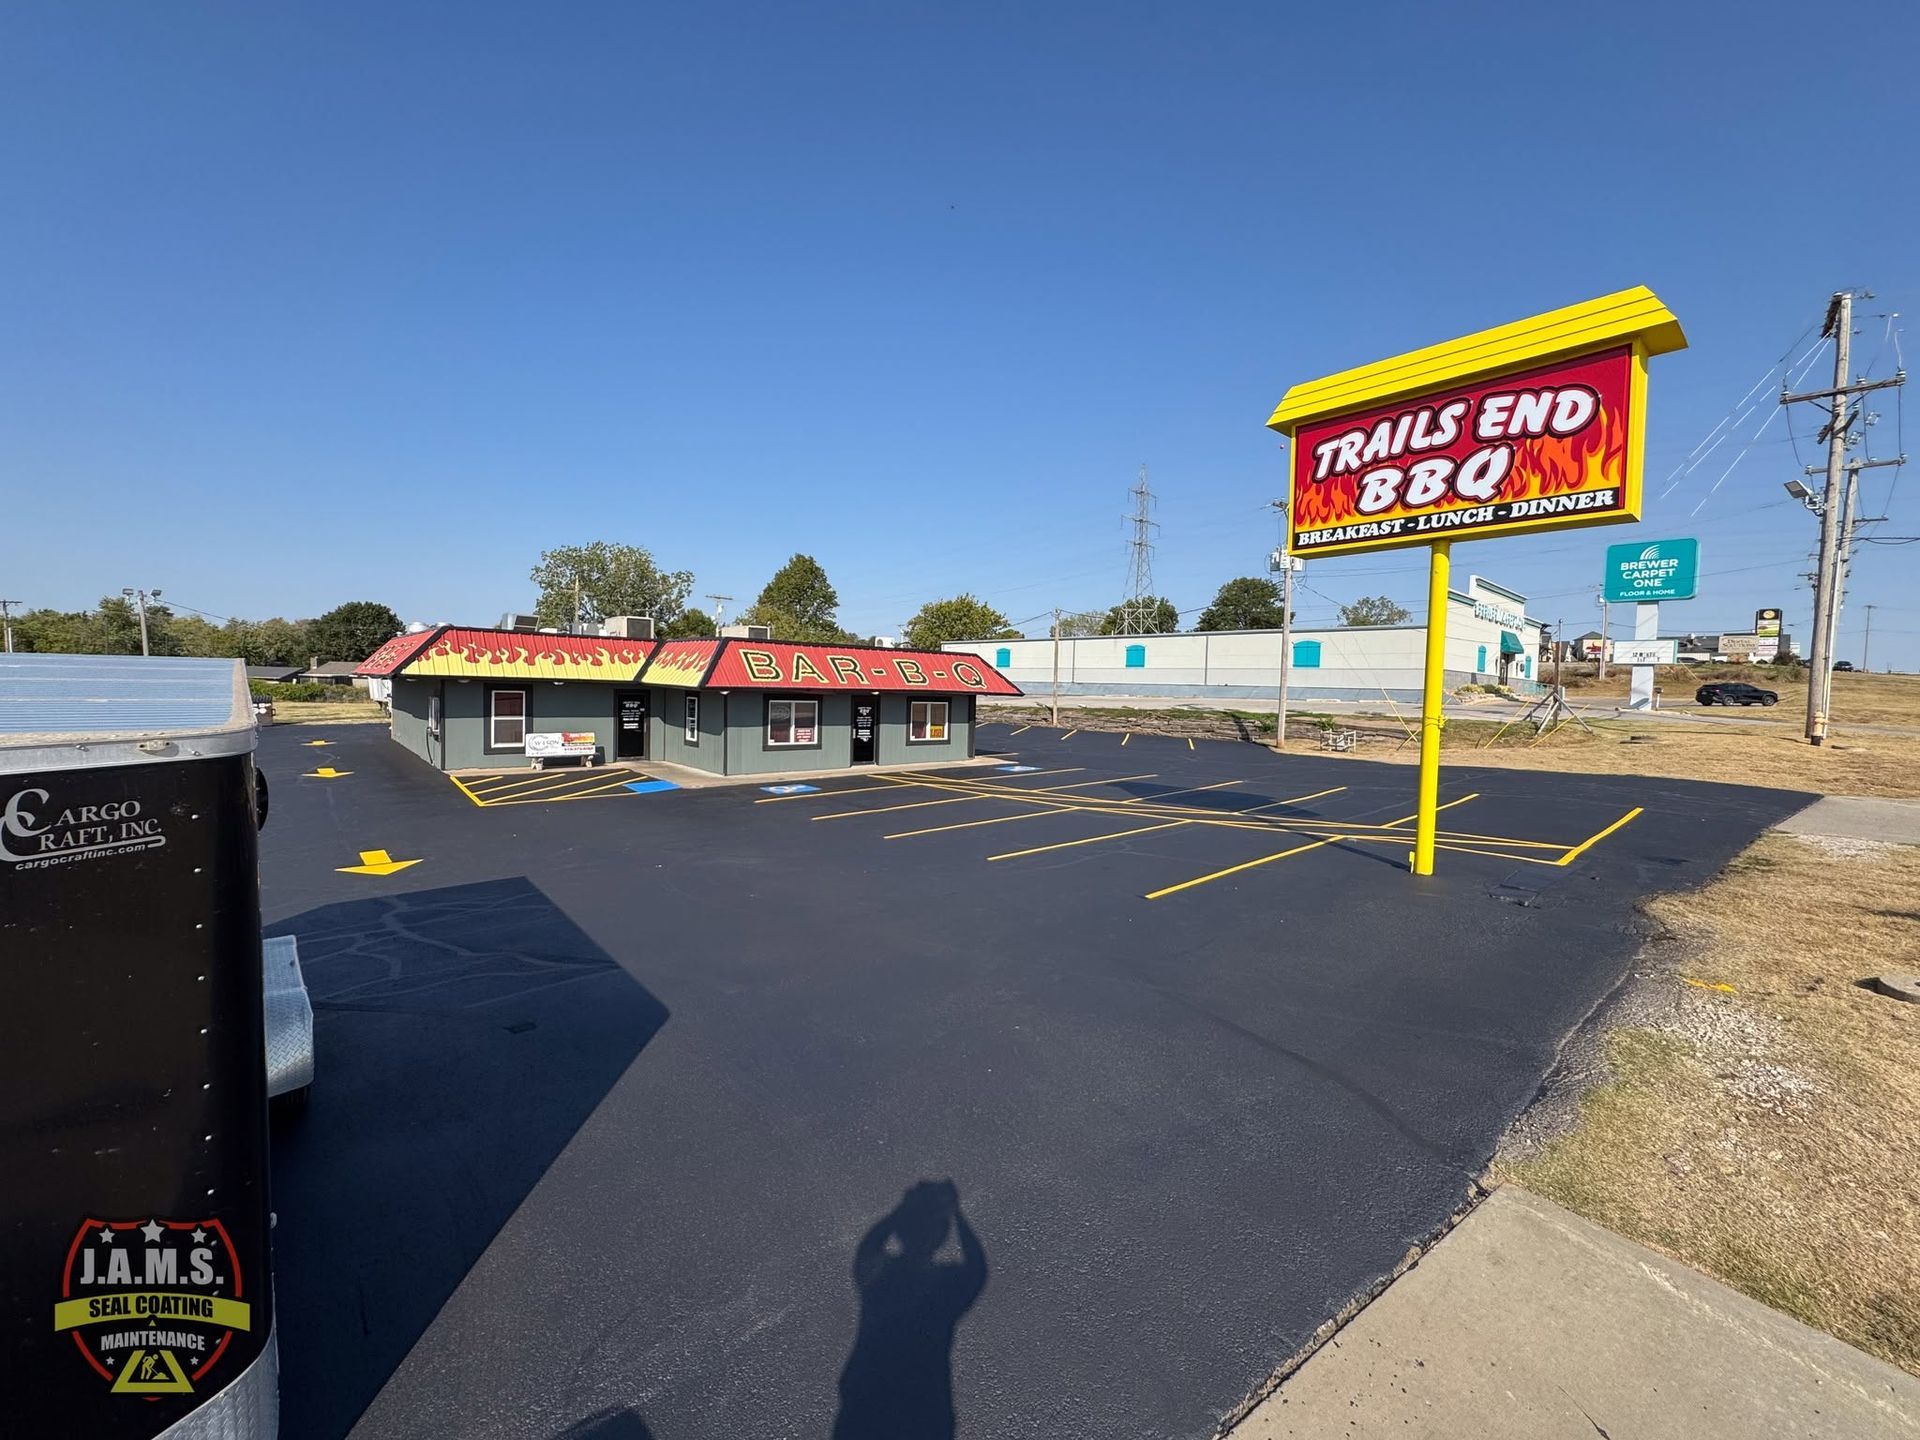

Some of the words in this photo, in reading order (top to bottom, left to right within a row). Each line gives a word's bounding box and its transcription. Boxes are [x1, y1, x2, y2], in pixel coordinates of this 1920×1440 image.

[1313, 400, 1469, 480] TRAILS
[1478, 387, 1600, 439] END
[1356, 443, 1514, 514] BBQ
[1297, 518, 1406, 546] BREAKFAST
[1416, 505, 1495, 531] LUNCH
[1509, 490, 1614, 518] DINNER
[1620, 558, 1679, 571] BREWER
[1622, 568, 1676, 580] CARPET
[1633, 578, 1663, 588] ONE
[1652, 588, 1676, 596] HOME
[738, 648, 988, 690] BAR-B-Q
[120, 819, 163, 839] INC.
[15, 843, 146, 871] cargocraftinc.com
